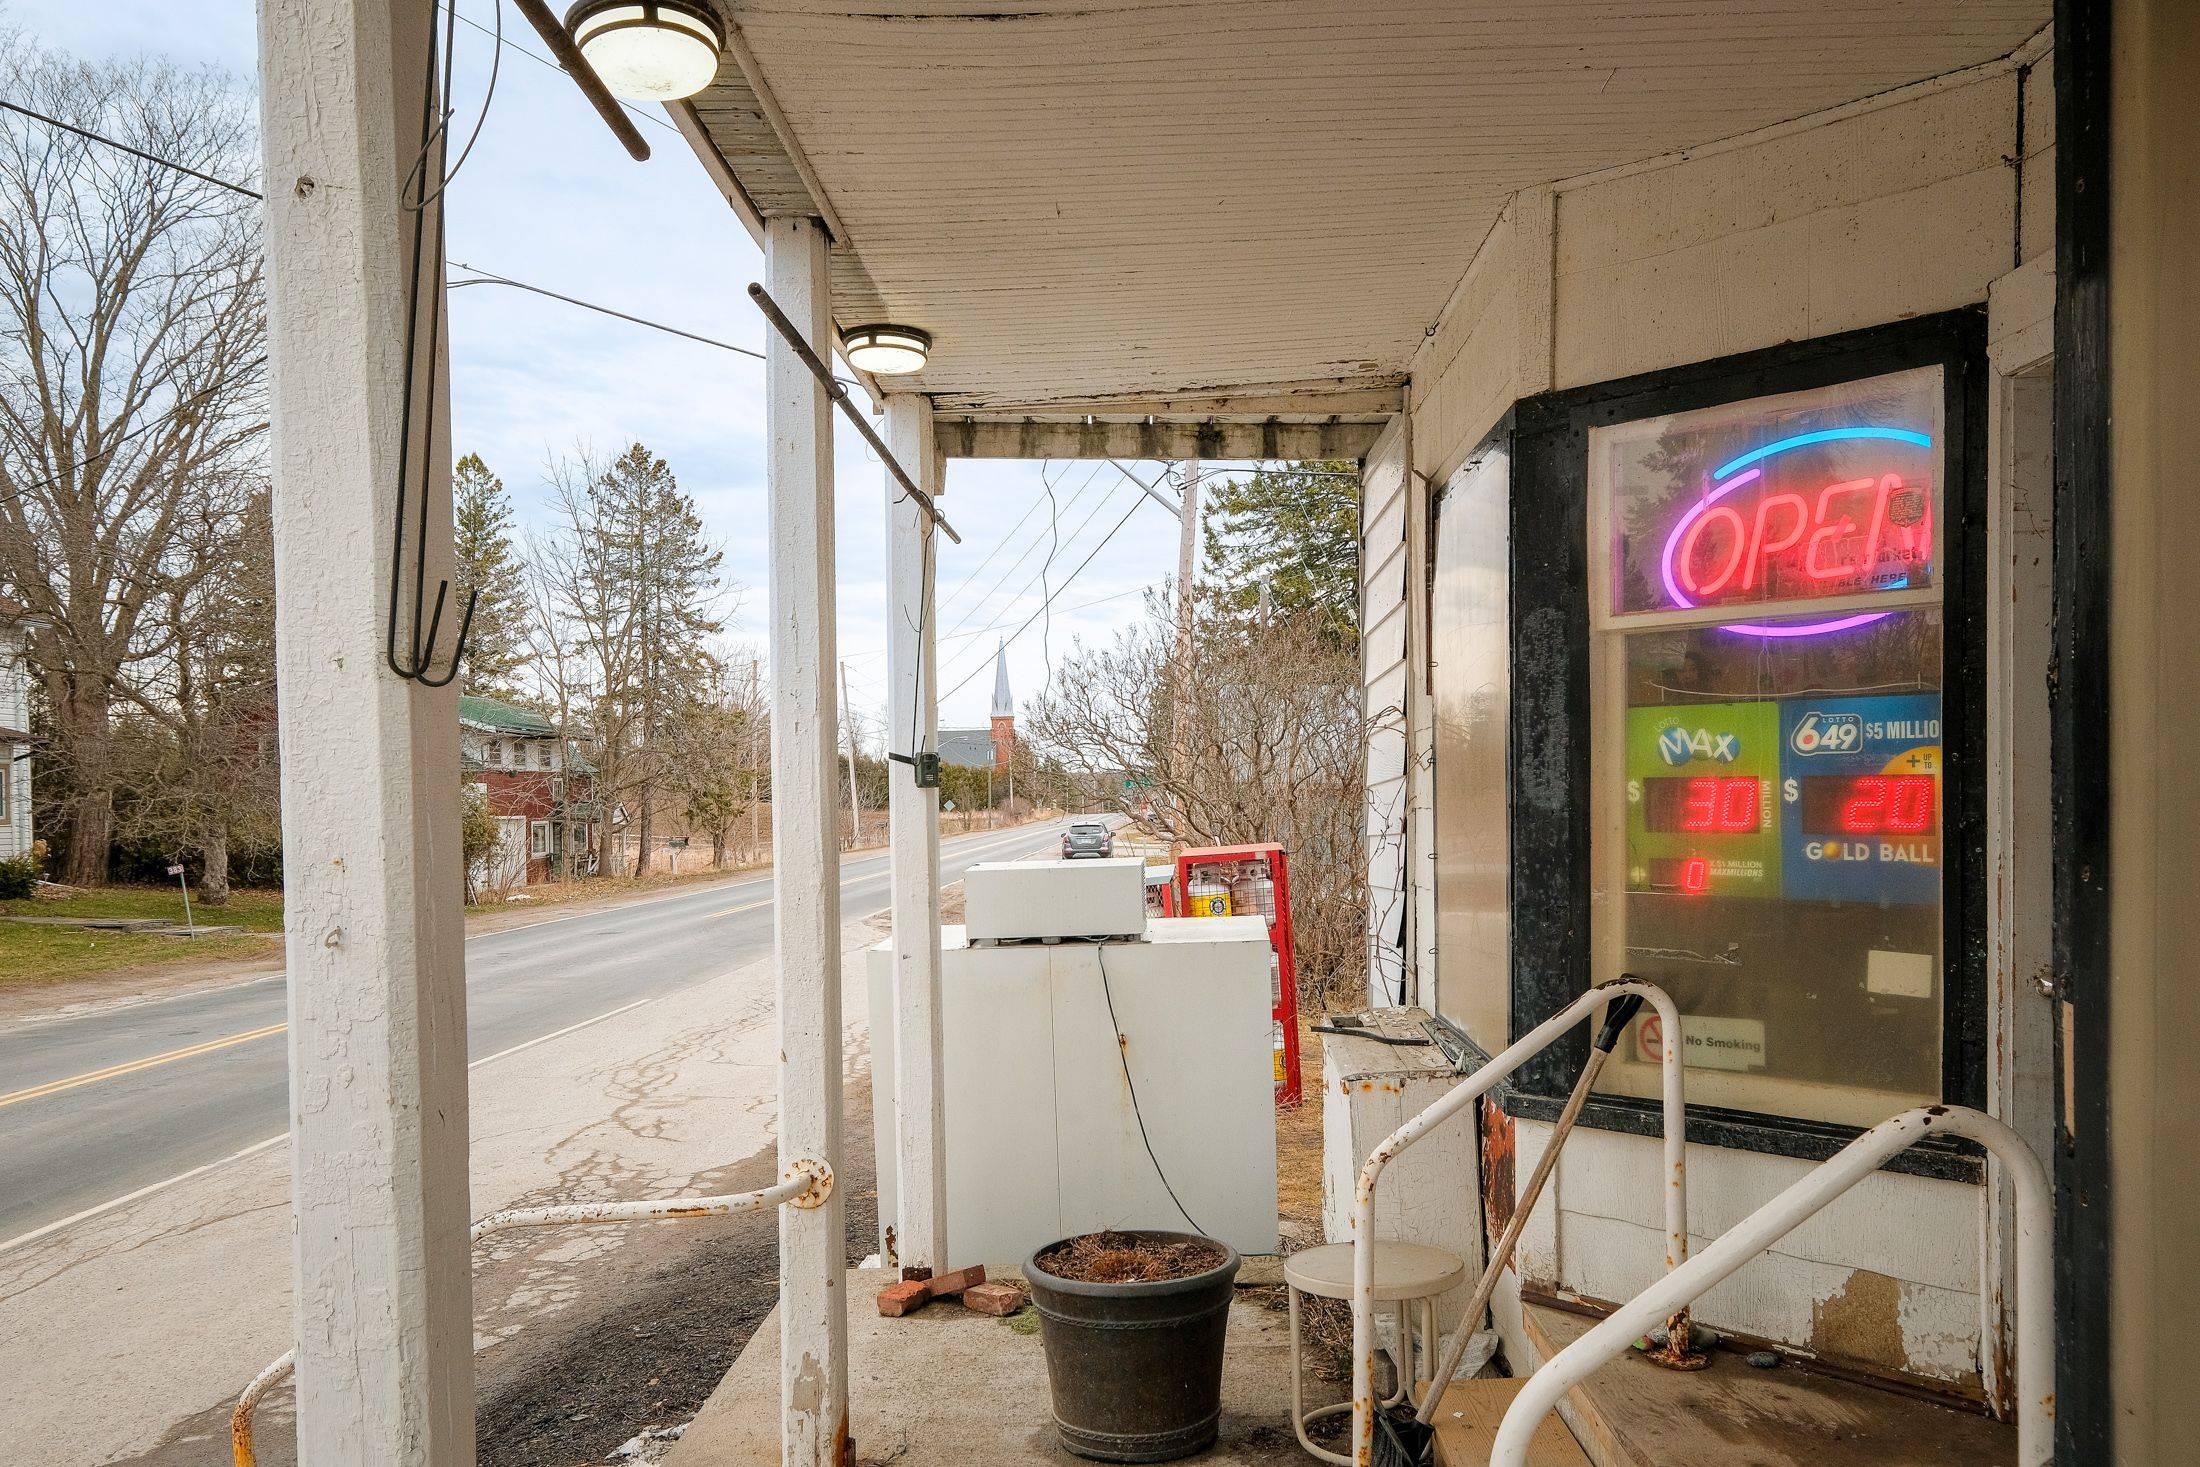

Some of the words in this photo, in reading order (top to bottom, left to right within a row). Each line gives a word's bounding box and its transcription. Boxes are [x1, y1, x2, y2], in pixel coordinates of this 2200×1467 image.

[1680, 473, 1932, 595] OPEN
[1796, 716, 1858, 751] 649
[1866, 722, 1884, 740] $5
[1659, 727, 1735, 765] MAX
[1923, 753, 1932, 761] UP
[1924, 761, 1932, 769] TO
[1627, 779, 1641, 805] $
[1783, 776, 1799, 804] $
[1848, 779, 1930, 828] 20
[1688, 781, 1756, 827] 30
[1879, 843, 1934, 862] BALL
[1687, 861, 1705, 888] 0
[1686, 1035, 1702, 1046] No
[1706, 1037, 1760, 1053] Smoking
